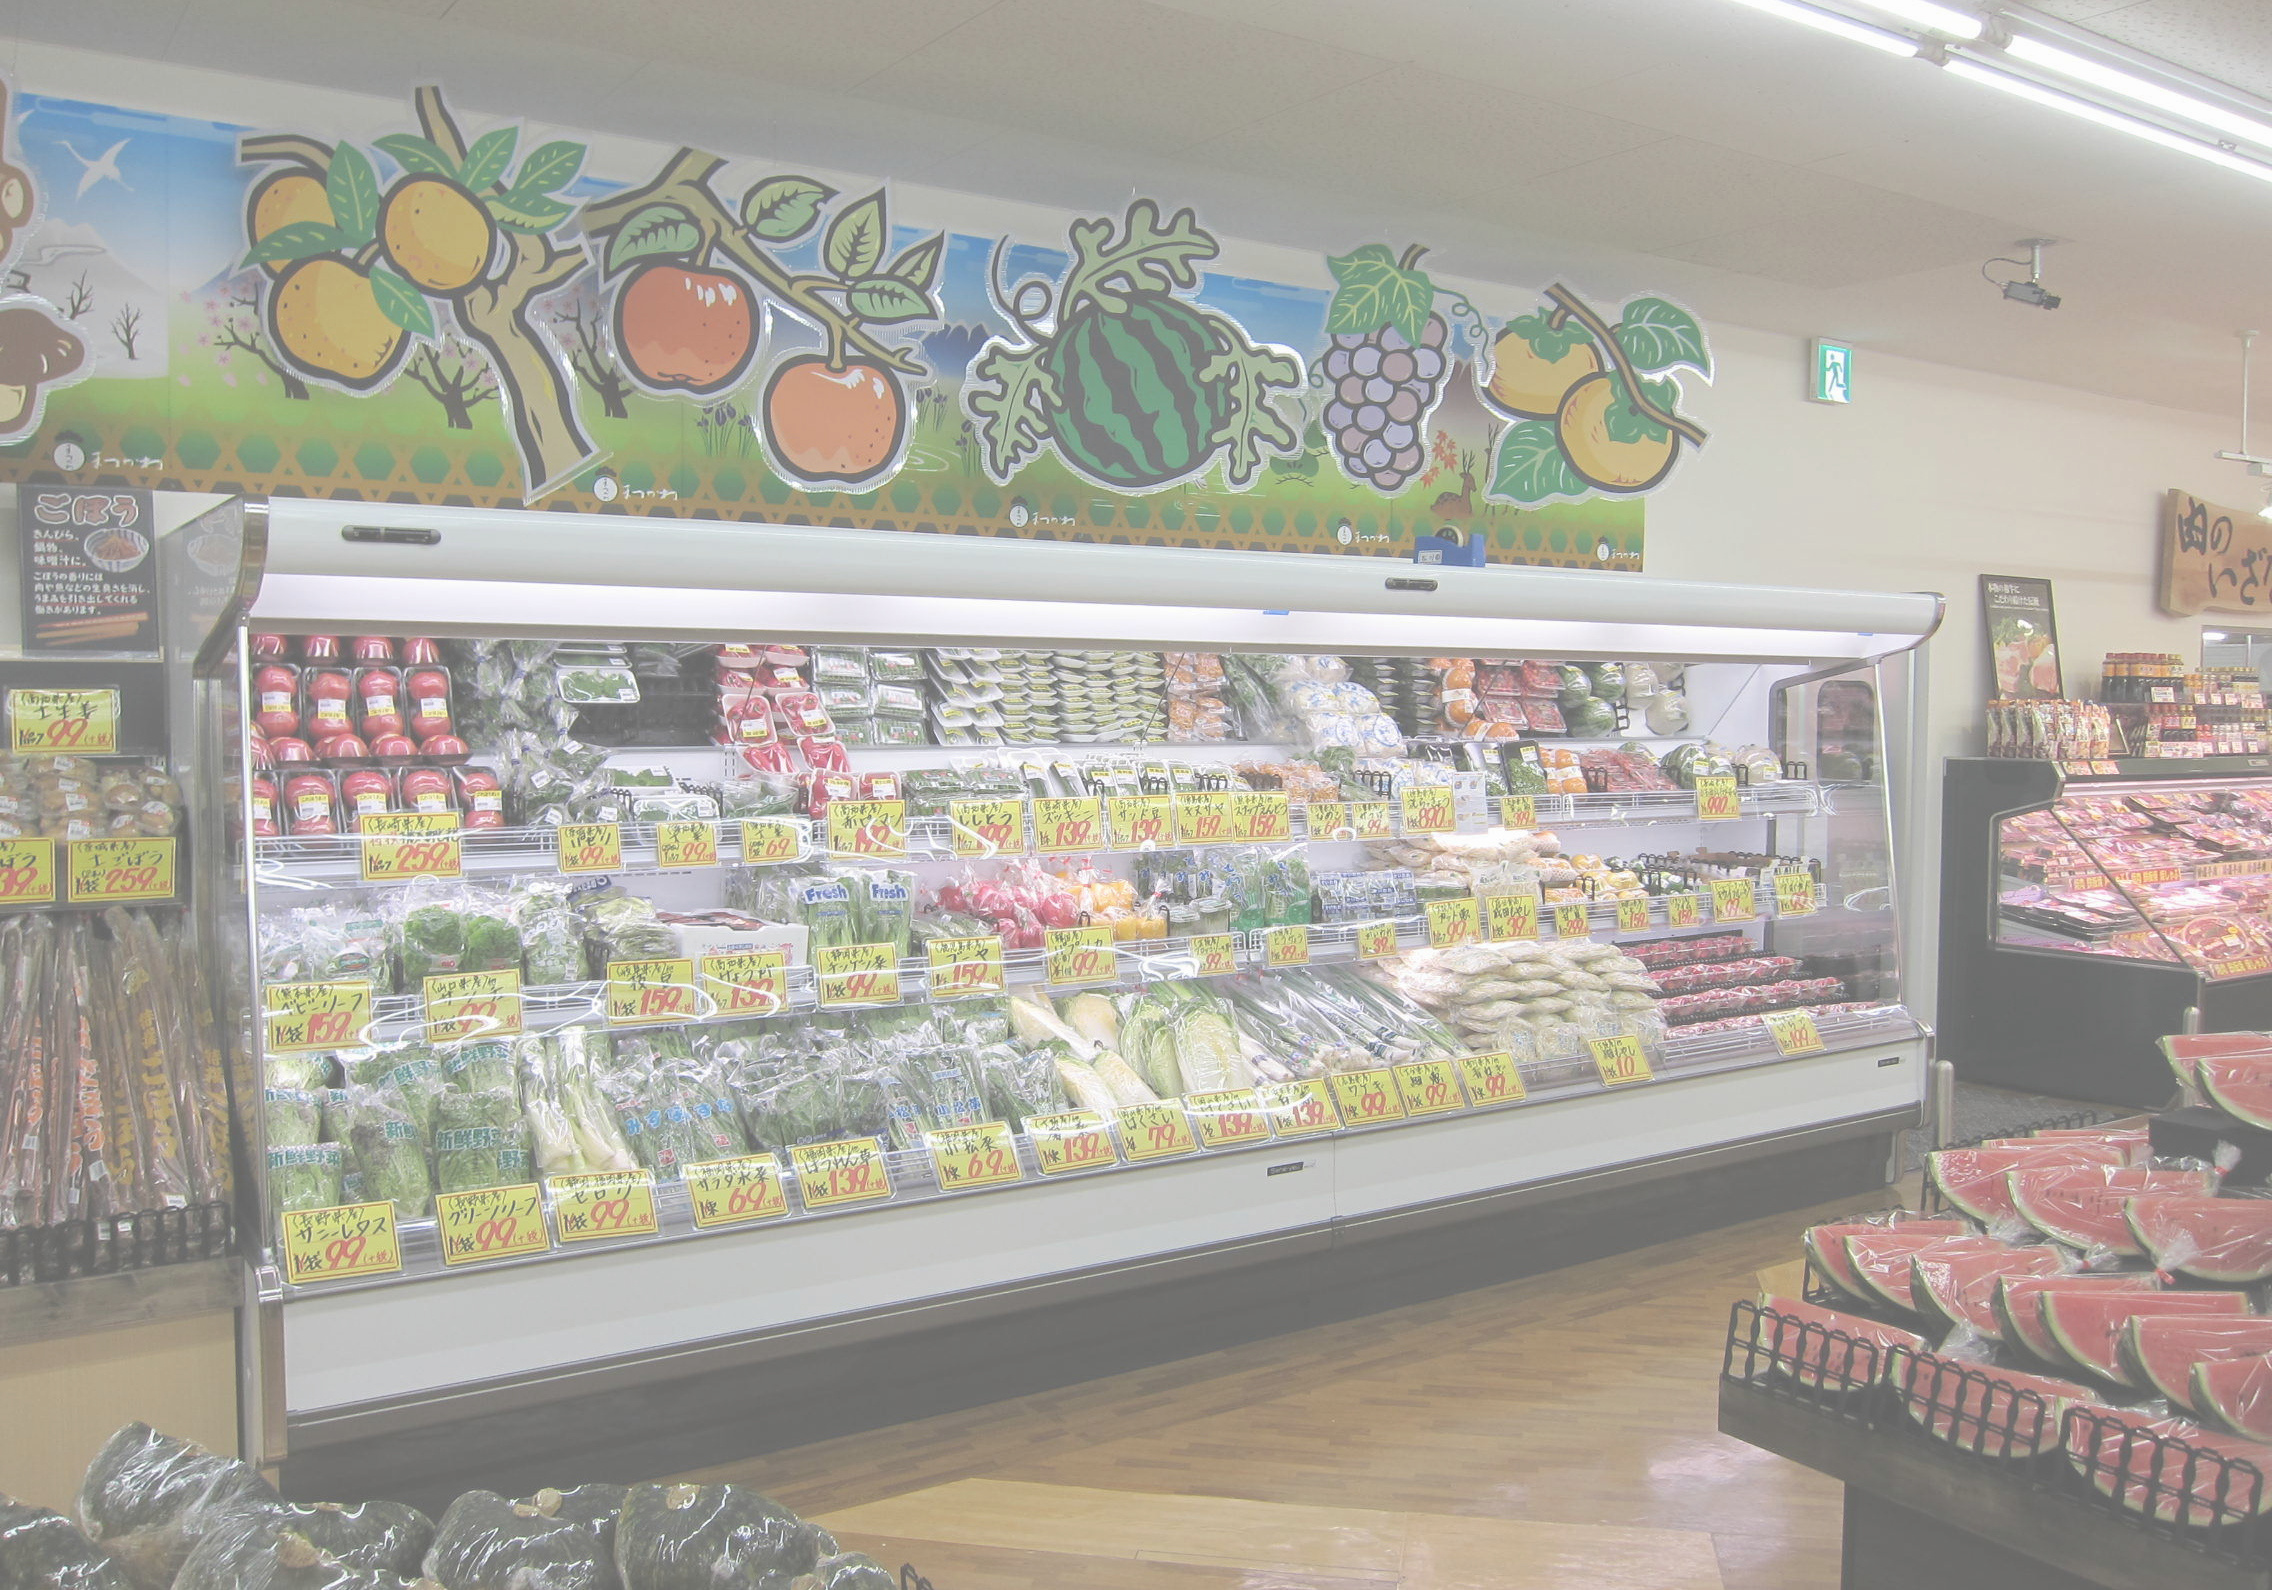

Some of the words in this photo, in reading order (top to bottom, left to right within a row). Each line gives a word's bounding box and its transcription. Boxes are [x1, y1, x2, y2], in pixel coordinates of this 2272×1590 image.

[2177, 497, 2233, 556] 肉の
[46, 718, 89, 747] 99
[959, 811, 1013, 827] ししとう
[1042, 808, 1095, 825] ズッキーニ
[1196, 815, 1221, 837] 159
[1249, 815, 1277, 837] 159
[1054, 820, 1092, 846] 139
[1130, 819, 1162, 843] 139
[394, 843, 451, 872] 259
[579, 846, 603, 865] 99
[682, 841, 708, 862] 99
[765, 837, 792, 856] 69
[104, 866, 158, 894] 259
[806, 885, 848, 901] Fresh
[872, 883, 907, 900] Fresh
[1447, 919, 1467, 942] 99
[1072, 951, 1099, 977] 99
[846, 973, 878, 998] 99
[640, 986, 684, 1016] 159
[306, 1011, 353, 1044] 159
[1616, 1056, 1636, 1077] 10
[1425, 1082, 1448, 1106] 99
[1485, 1075, 1506, 1097] 99
[1292, 1100, 1325, 1127] 139
[1360, 1091, 1387, 1117] 99
[1148, 1123, 1176, 1151] 79
[1217, 1112, 1252, 1138] 139
[1063, 1132, 1100, 1163] 139
[968, 1149, 1004, 1179] 69
[828, 1163, 872, 1197] 139
[571, 1183, 632, 1205] セロリ
[727, 1181, 767, 1215] 69
[448, 1196, 537, 1227] グリーンリーフ
[589, 1198, 630, 1231] 99
[296, 1216, 388, 1243] サニーレタス
[475, 1216, 519, 1251] 99
[325, 1236, 368, 1270] 99
